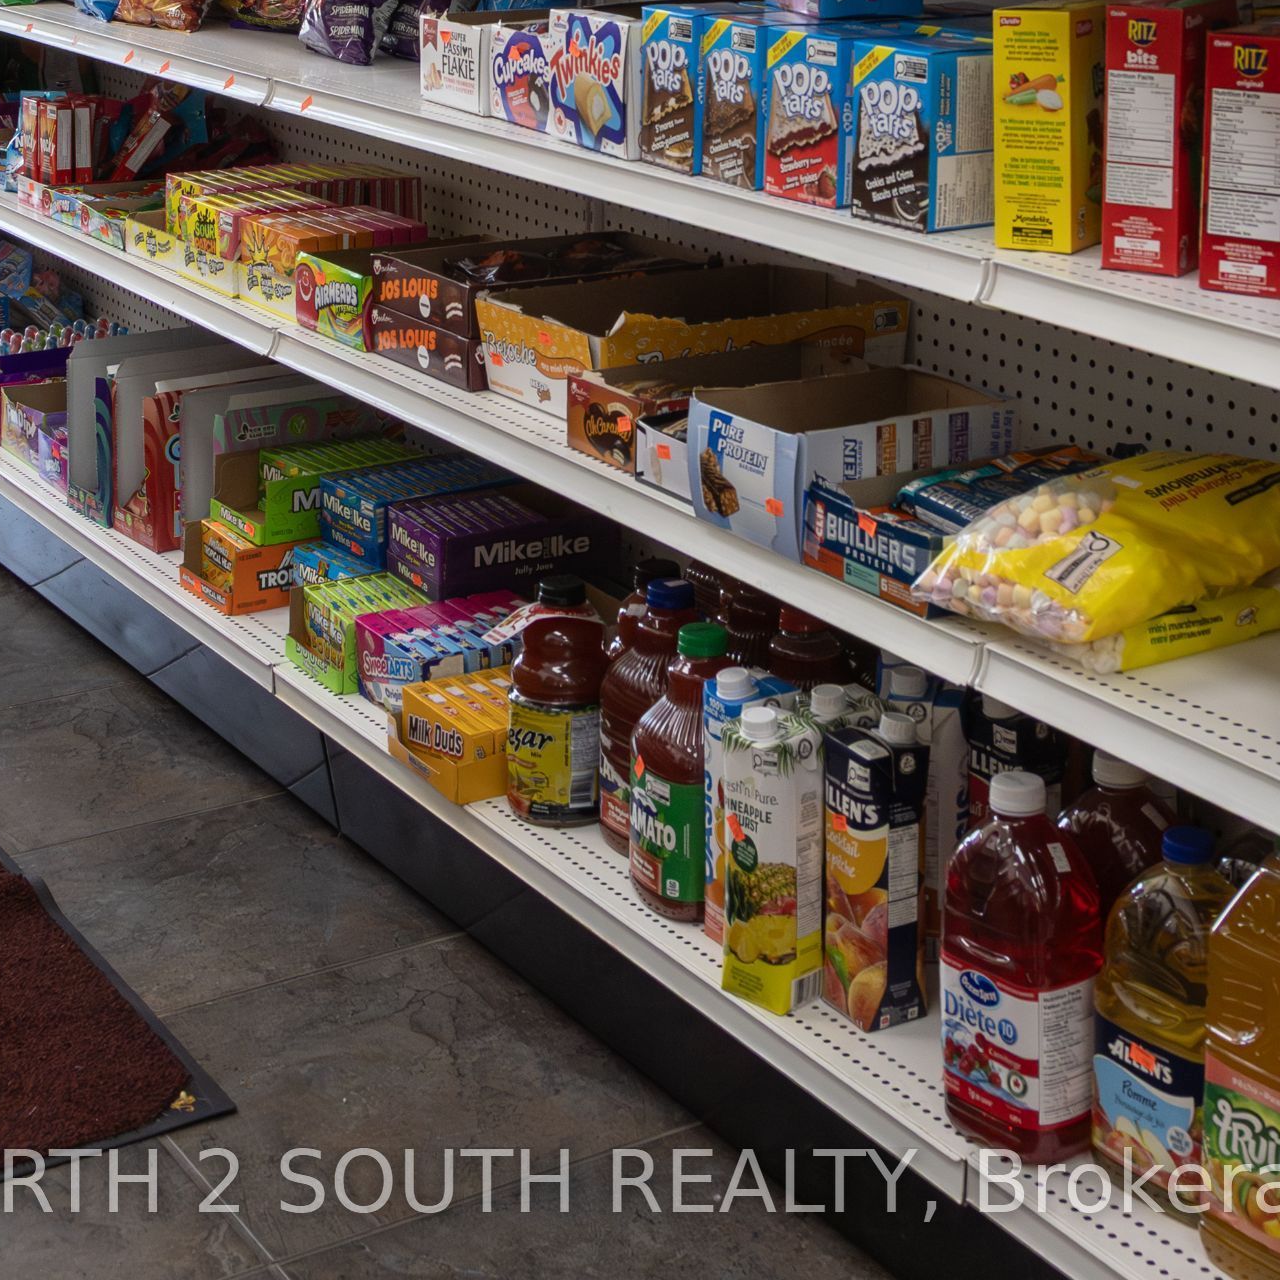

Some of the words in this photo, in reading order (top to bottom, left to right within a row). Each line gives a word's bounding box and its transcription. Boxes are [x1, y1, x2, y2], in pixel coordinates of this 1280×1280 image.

[451, 32, 466, 42] SUPER
[1128, 20, 1157, 41] RITZ
[550, 36, 621, 102] Twinkies
[1126, 49, 1158, 65] bits
[1234, 46, 1268, 71] RITZ
[651, 68, 682, 92] tarts
[713, 76, 745, 104] tarts
[1236, 80, 1264, 89] original
[783, 92, 824, 120] tarts
[870, 113, 914, 141] tarts
[779, 157, 810, 173] Strawberry
[799, 173, 818, 184] fraises
[866, 176, 884, 190] Cookies
[896, 168, 914, 180] Crème
[872, 188, 891, 203] Biscuits
[195, 222, 216, 239] SOUR
[314, 281, 358, 310] AIRHEADS
[380, 281, 401, 302] JOS
[402, 278, 438, 301] LOUIS
[377, 331, 398, 350] JOS
[399, 329, 437, 351] LOUIS
[483, 329, 537, 367] Brioche
[712, 418, 744, 443] PURE
[717, 439, 769, 470] PROTEIN
[323, 491, 351, 520] Mike
[352, 511, 372, 533] Ike
[391, 522, 418, 552] Mike
[418, 540, 436, 568] Ike
[474, 540, 540, 569] Mike
[551, 534, 591, 555] Ike
[826, 513, 917, 576] BUILDERS
[845, 545, 894, 575] PROTEIN
[880, 577, 888, 591] 6
[407, 712, 433, 750] Milk
[435, 725, 464, 758] Duds
[944, 987, 997, 1037] Diète
[999, 1021, 1014, 1040] 10
[1122, 1080, 1158, 1112] Pomme
